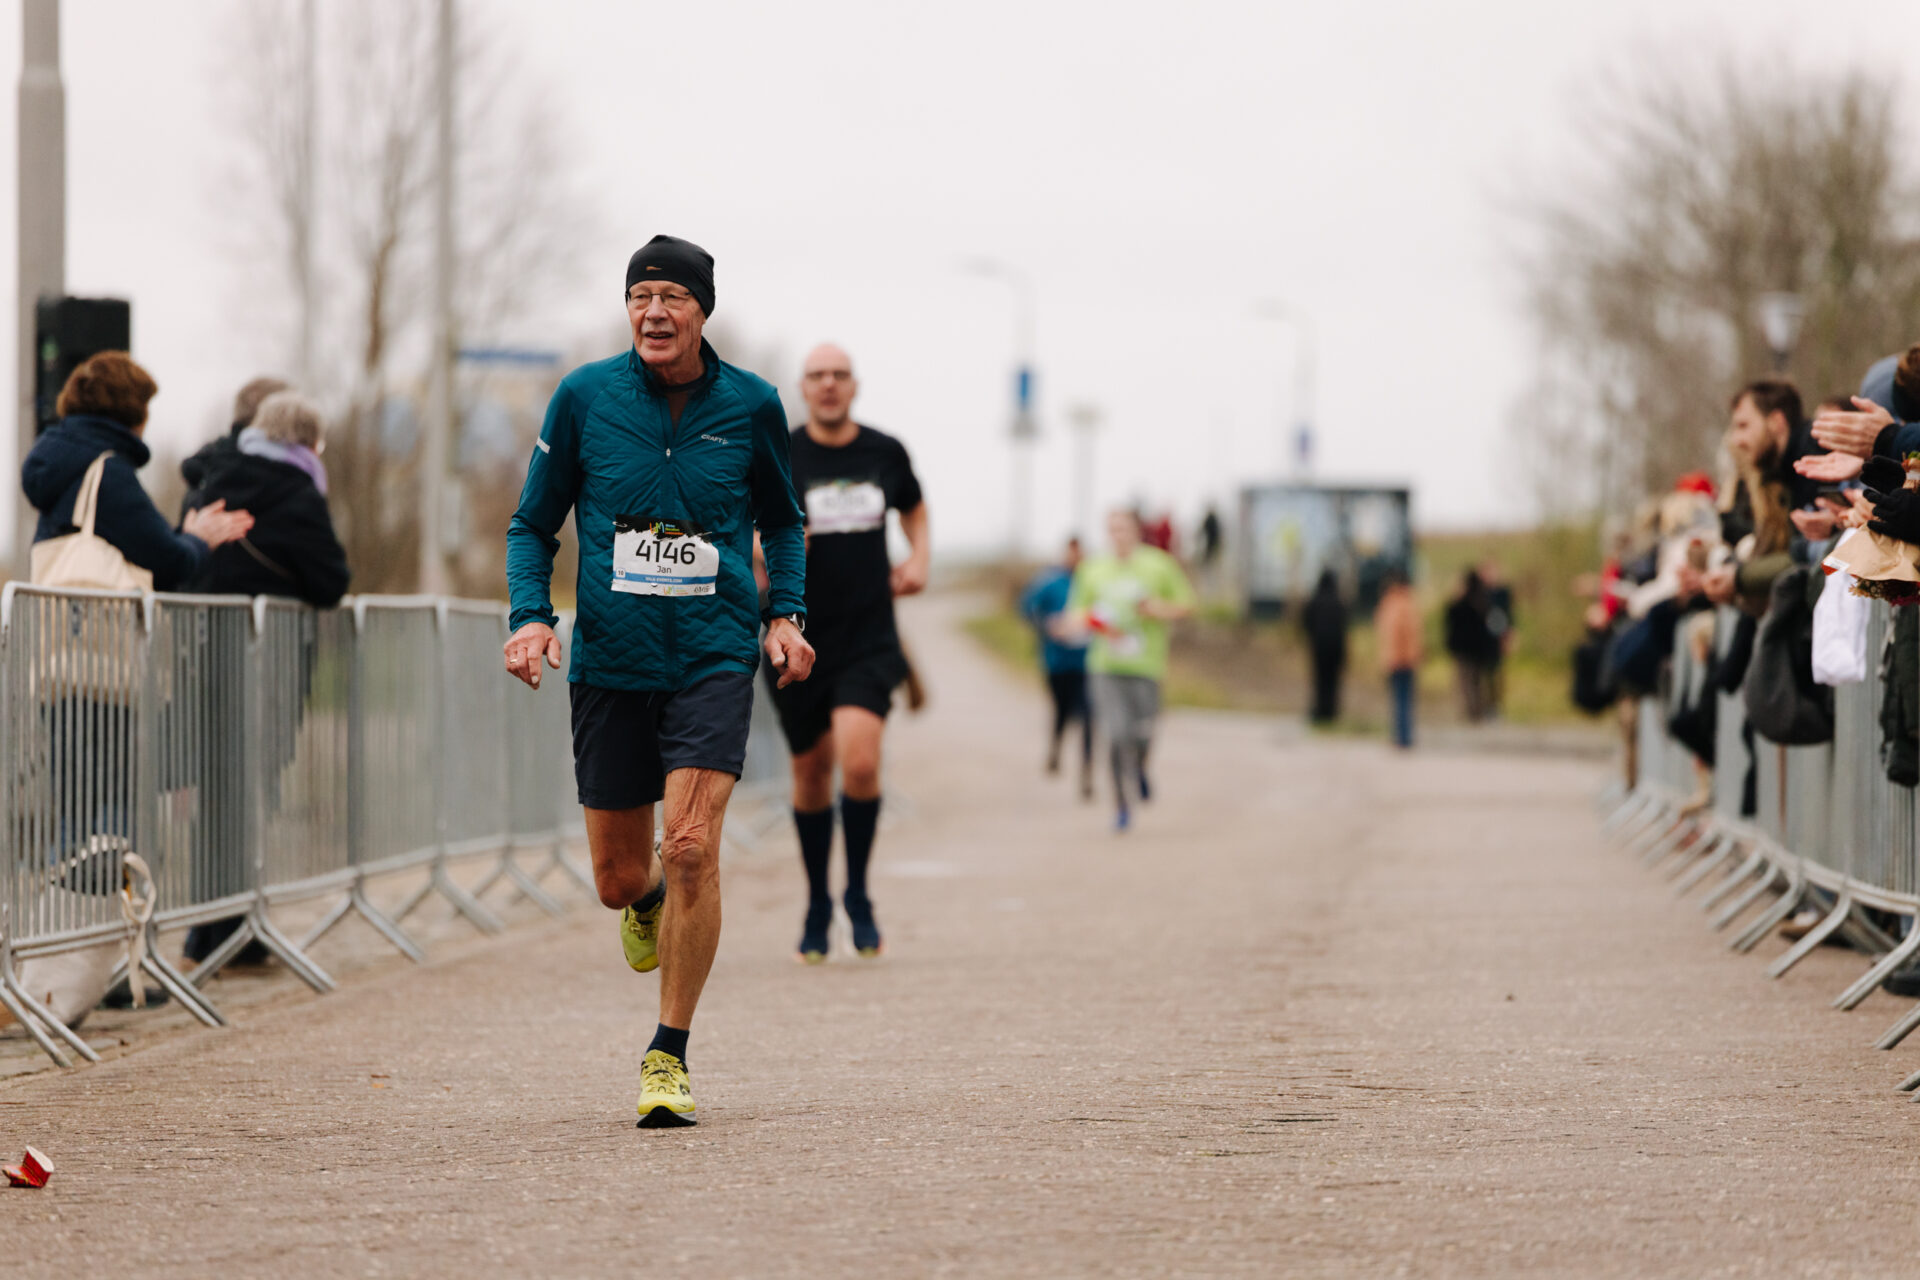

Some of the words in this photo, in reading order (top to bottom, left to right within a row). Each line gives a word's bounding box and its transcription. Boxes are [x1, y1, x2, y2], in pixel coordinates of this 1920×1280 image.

[701, 434, 723, 443] CRAFT
[635, 539, 696, 565] 4146
[656, 565, 672, 574] Jan
